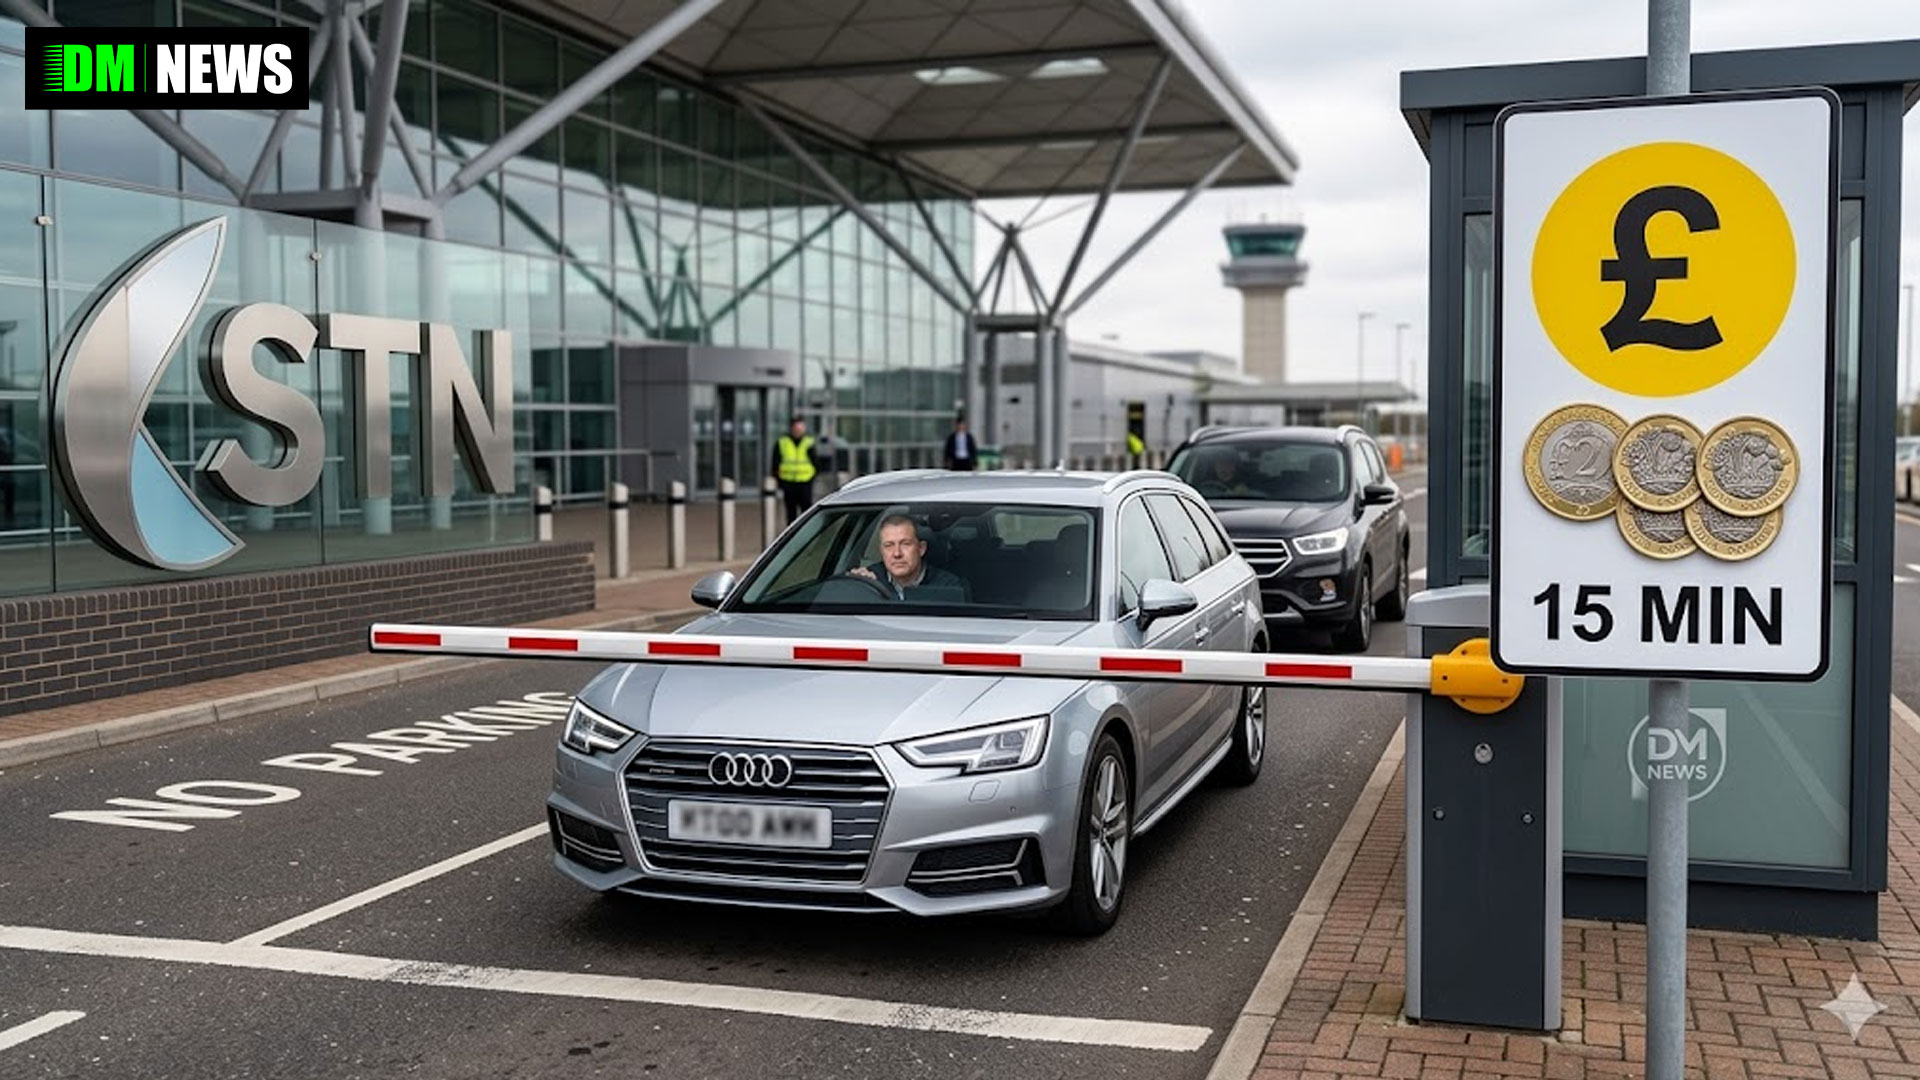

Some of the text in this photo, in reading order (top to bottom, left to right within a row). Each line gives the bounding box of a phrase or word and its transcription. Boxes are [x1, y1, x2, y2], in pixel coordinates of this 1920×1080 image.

[1600, 185, 1724, 352] £
[196, 302, 515, 507] STN
[1533, 583, 1783, 646] 15 MIN
[49, 780, 302, 832] NO
